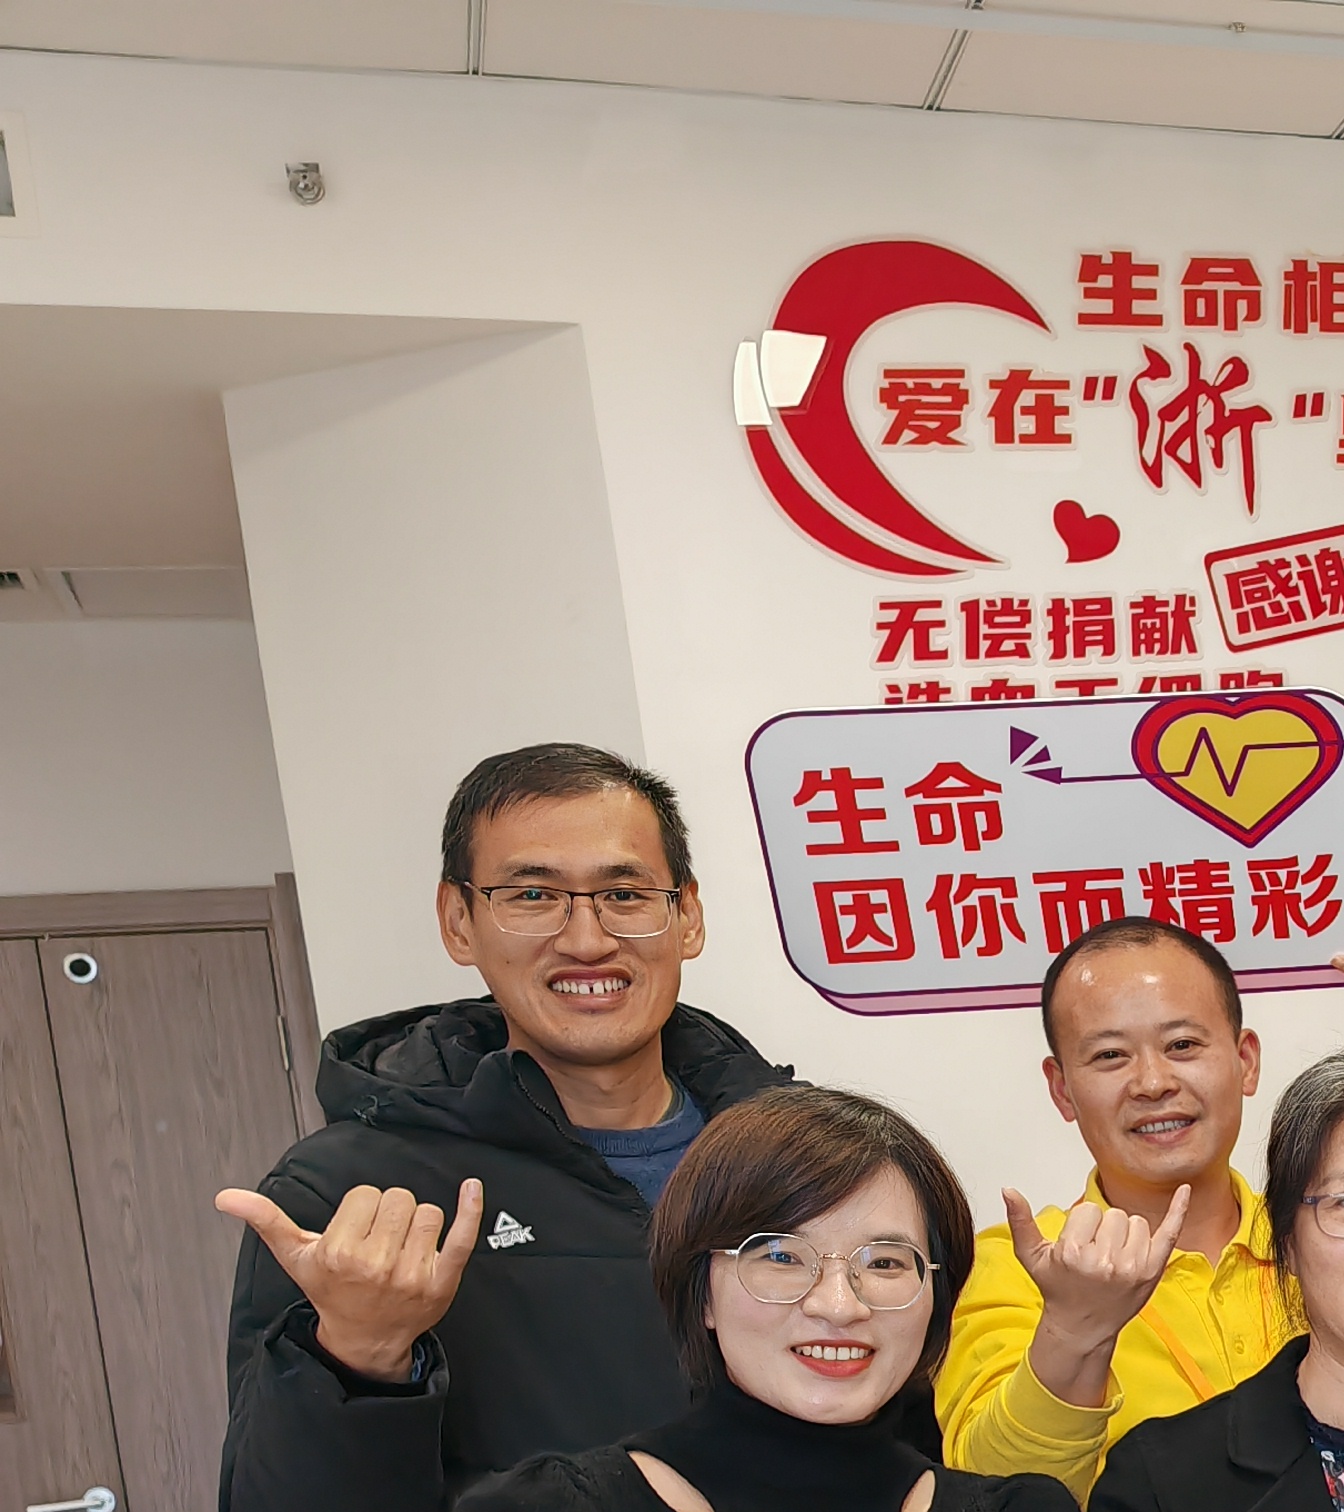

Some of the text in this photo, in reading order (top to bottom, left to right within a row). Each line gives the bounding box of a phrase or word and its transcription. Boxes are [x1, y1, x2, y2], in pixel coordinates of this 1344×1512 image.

[873, 596, 1198, 662] 无偿捐献
[793, 760, 1003, 857] 生命
[813, 853, 1343, 966] 因你而精彩
[486, 1226, 536, 1250] PEAK
